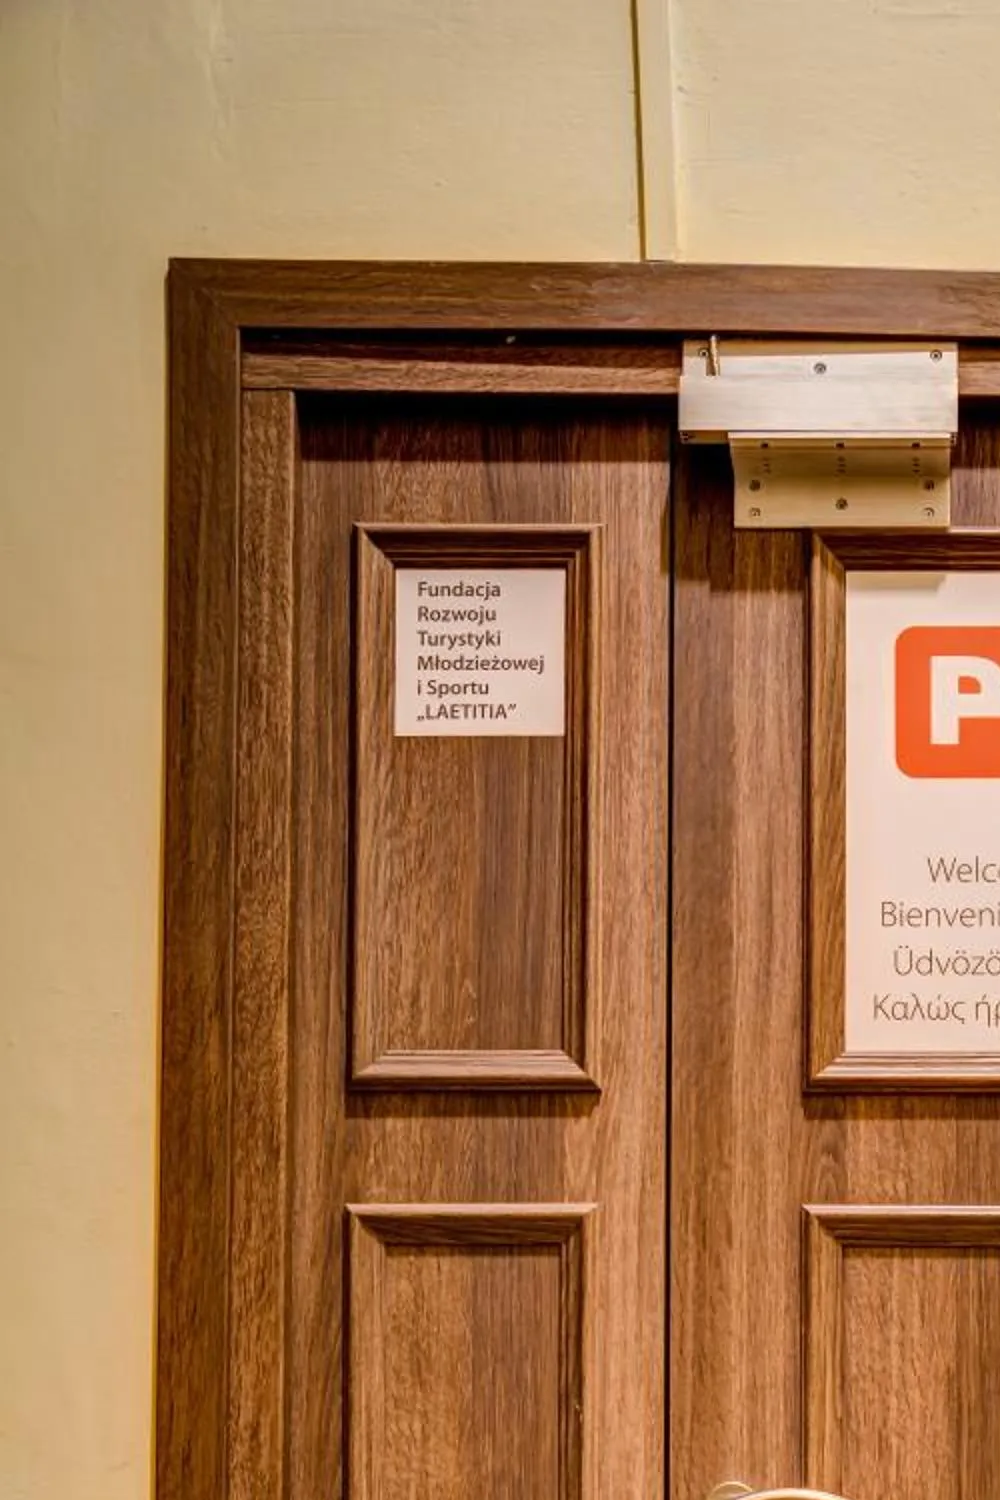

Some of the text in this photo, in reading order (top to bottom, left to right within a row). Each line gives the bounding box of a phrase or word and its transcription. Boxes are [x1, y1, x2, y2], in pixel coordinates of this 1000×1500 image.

[417, 581, 501, 600] Fundacja
[417, 605, 497, 625] Rozwoju
[417, 630, 501, 650] Turystyki
[417, 653, 545, 675] Młodzieżowej
[417, 679, 490, 699] i Sportu
